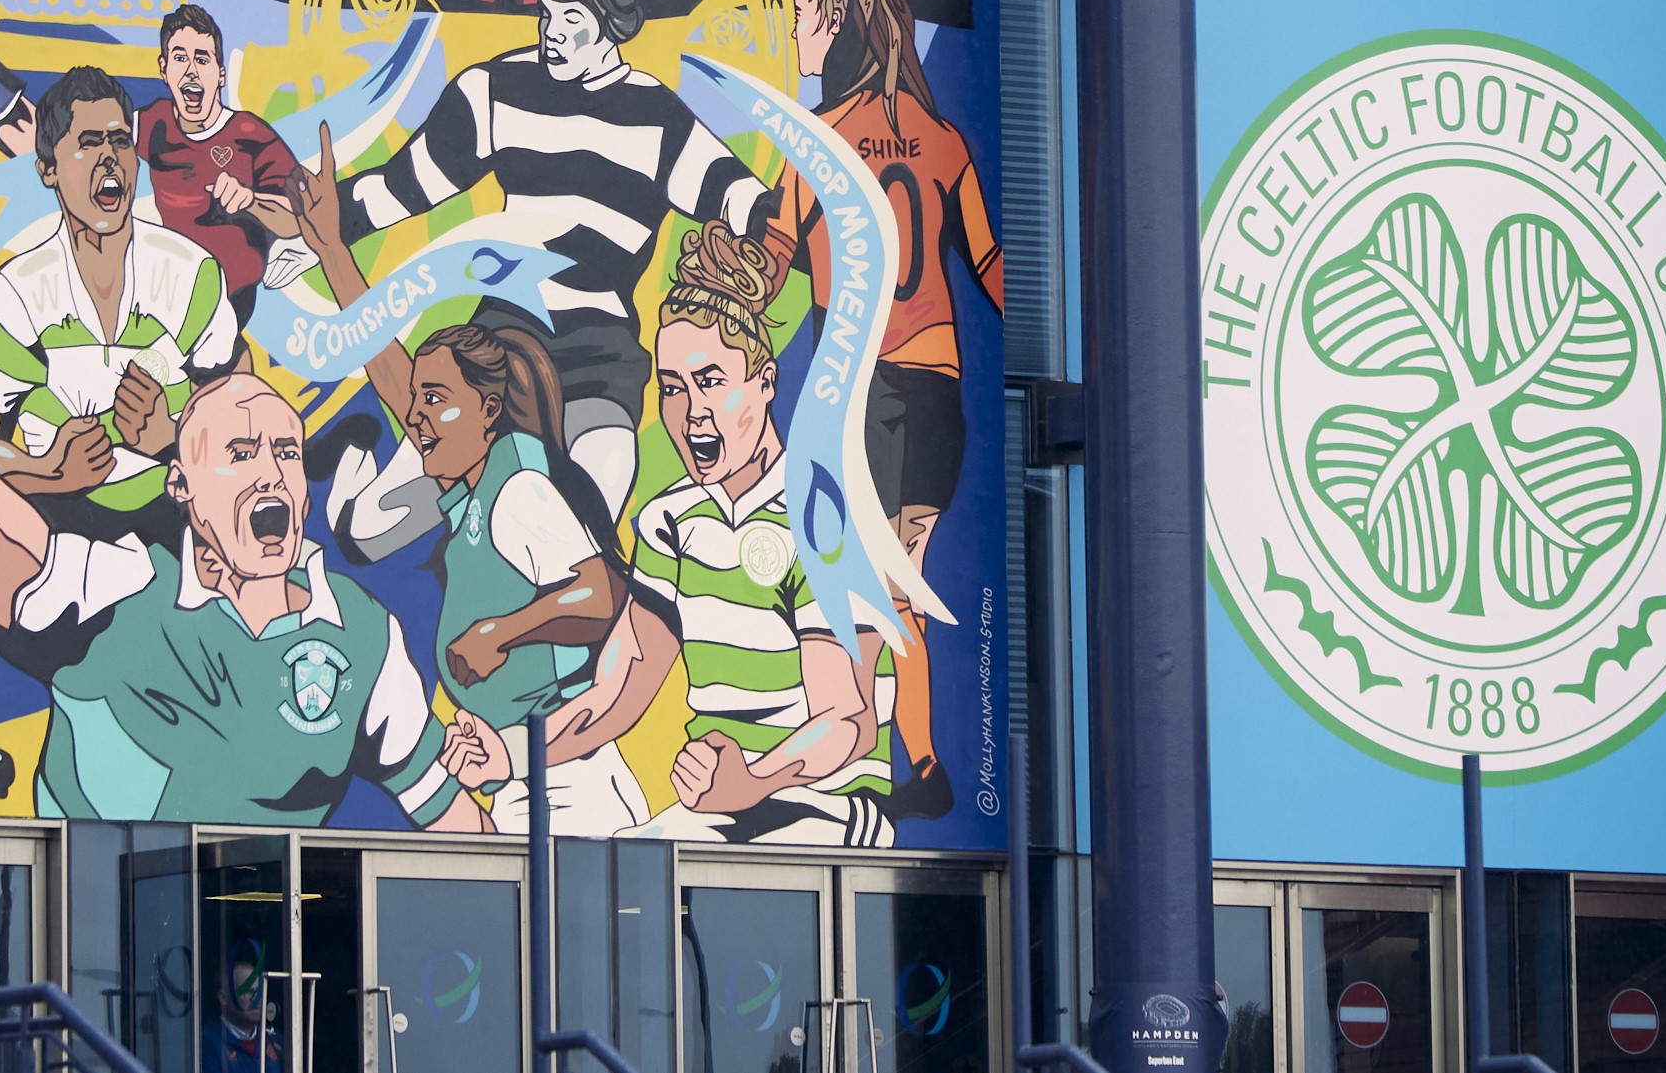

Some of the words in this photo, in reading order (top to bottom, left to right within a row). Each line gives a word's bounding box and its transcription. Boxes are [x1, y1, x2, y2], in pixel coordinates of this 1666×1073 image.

[858, 137, 921, 160] SHINE
[1202, 263, 1266, 399] THE
[1237, 88, 1389, 257] CELTIC
[1400, 71, 1663, 248] FOOTBALL
[286, 305, 388, 369] SCOTTISH
[387, 263, 436, 319] GAS
[814, 205, 870, 406] MOMENTS
[1425, 673, 1541, 739] 1888
[1132, 1030, 1199, 1040] HAMPDEN
